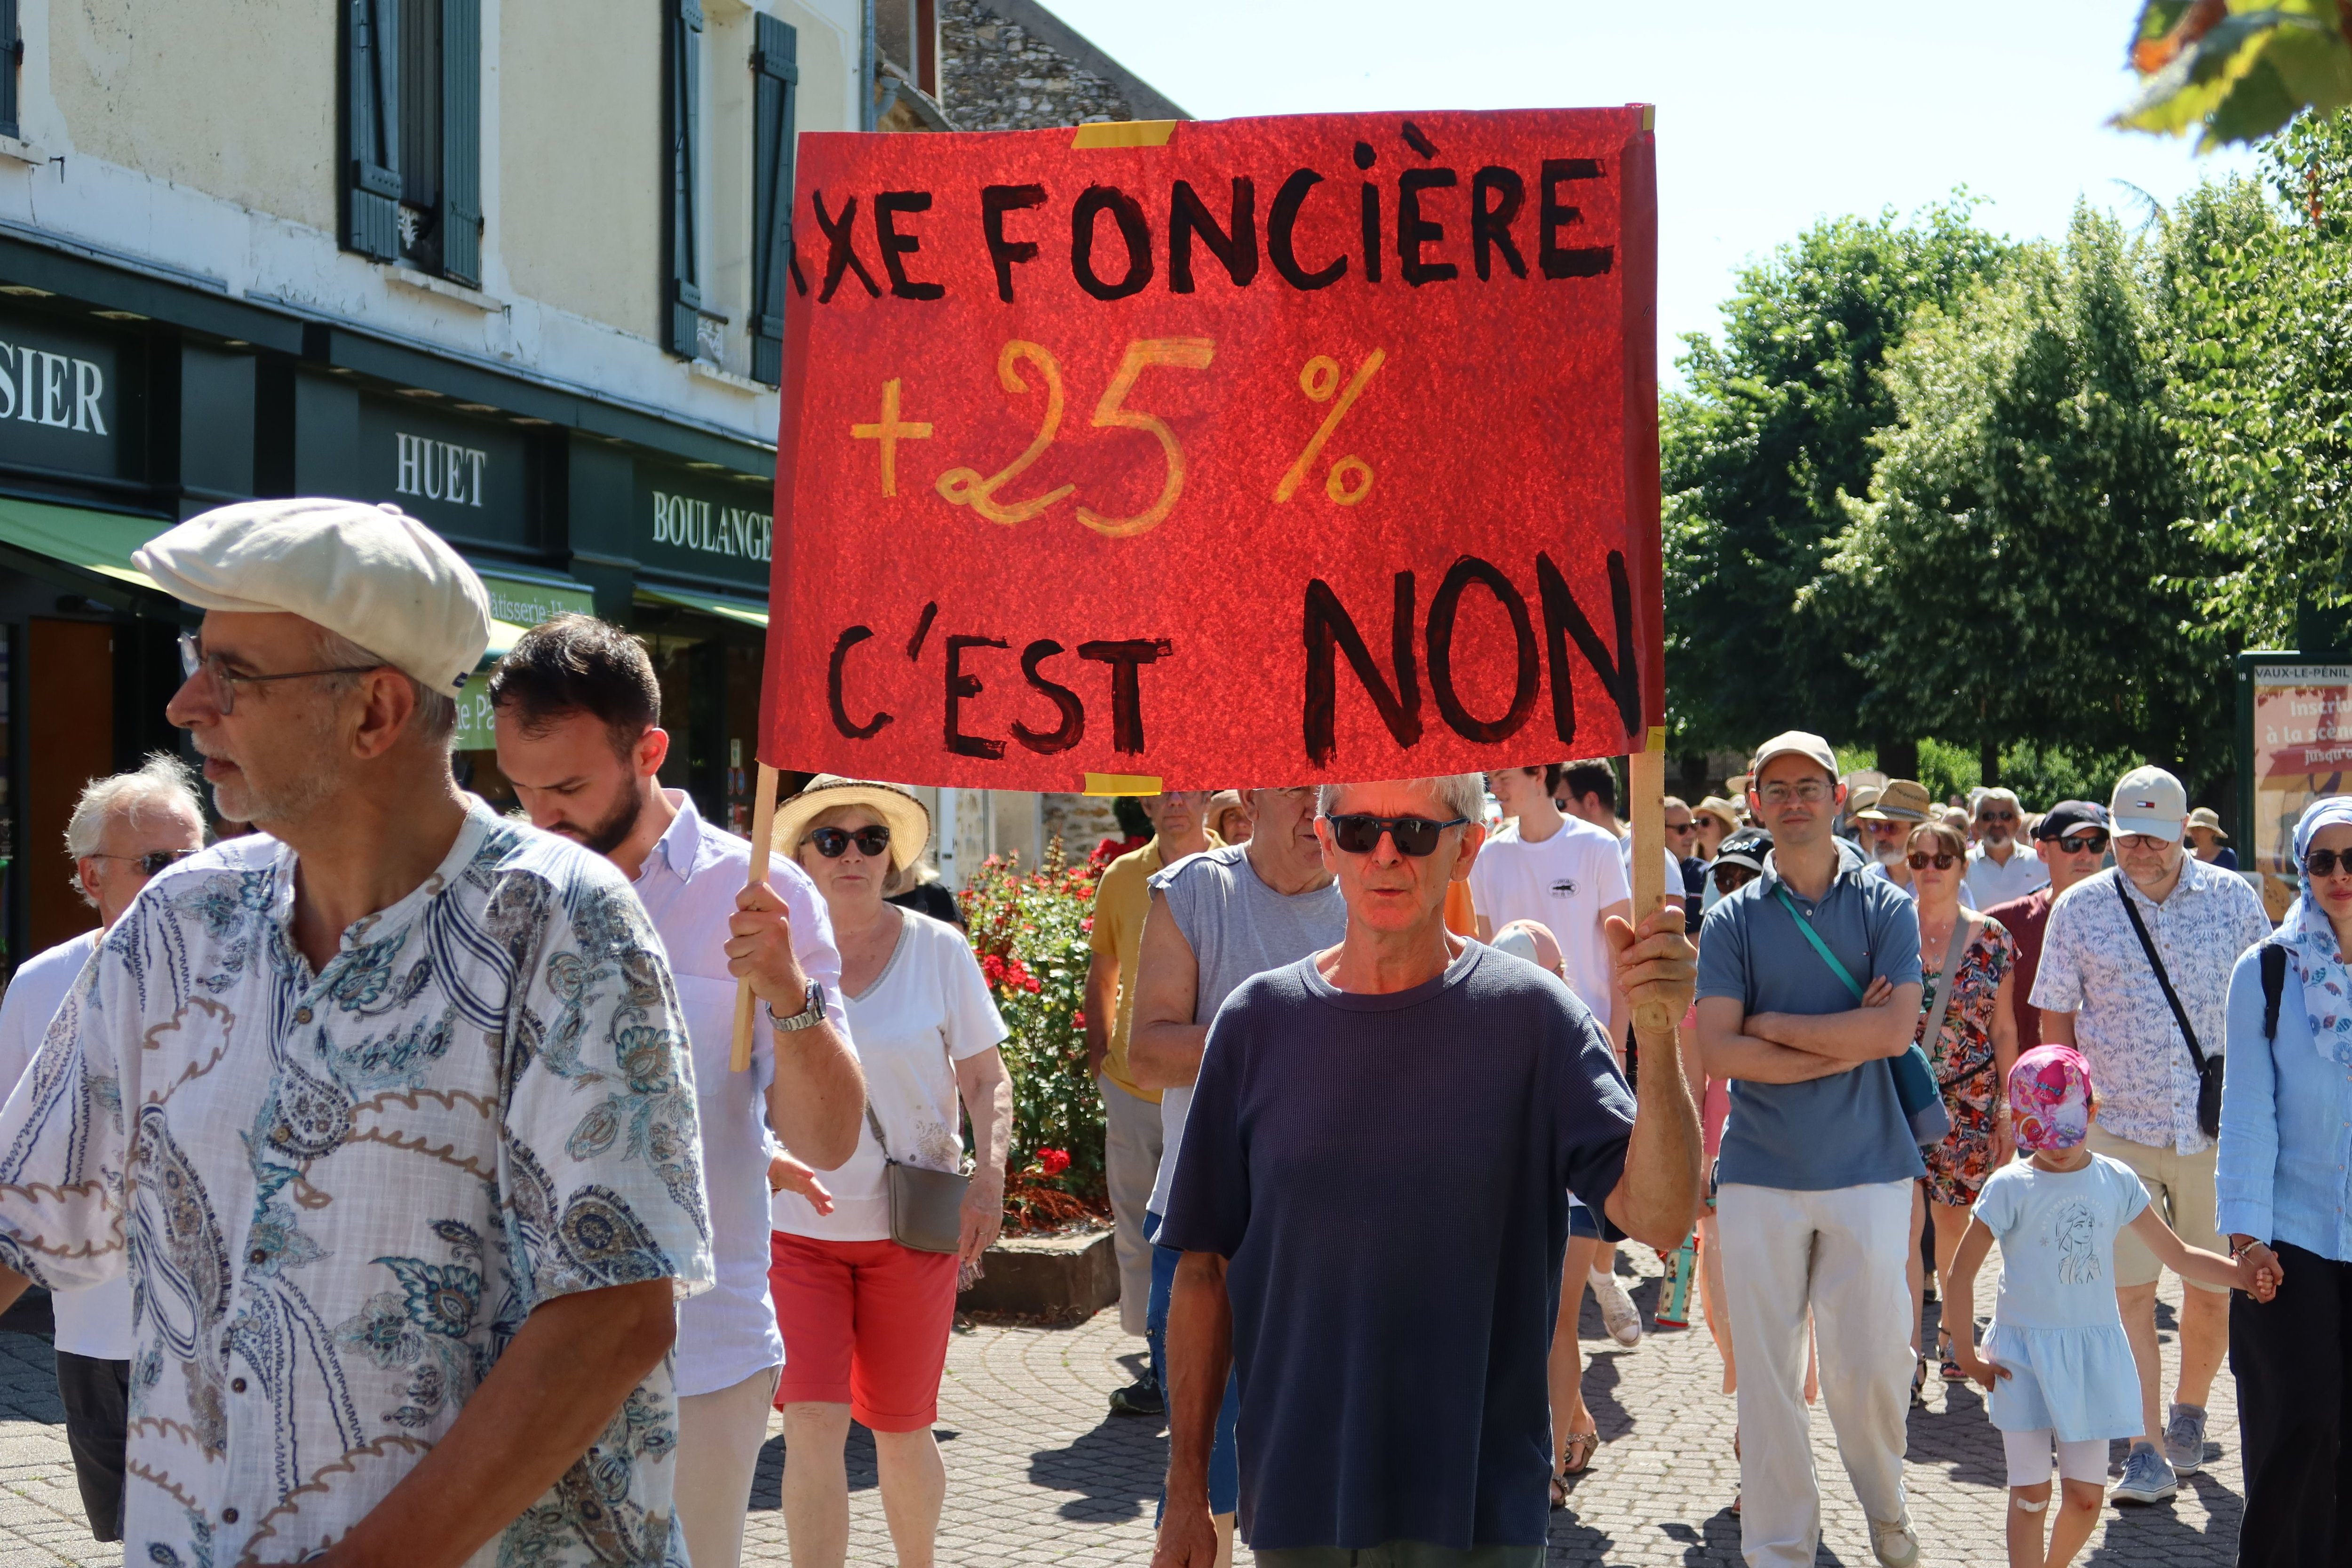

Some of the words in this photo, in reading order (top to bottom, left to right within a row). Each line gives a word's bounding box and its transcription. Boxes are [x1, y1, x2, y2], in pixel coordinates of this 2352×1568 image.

[395, 432, 486, 507] HUET
[652, 491, 773, 563] BOULANGE
[827, 601, 1173, 760] C'EST
[1303, 549, 1642, 770] NON
[2255, 665, 2350, 678] VAUX-LE-PÉNIL
[2266, 725, 2278, 745] à
[2284, 725, 2303, 743] la
[1722, 837, 1761, 852] Cool
